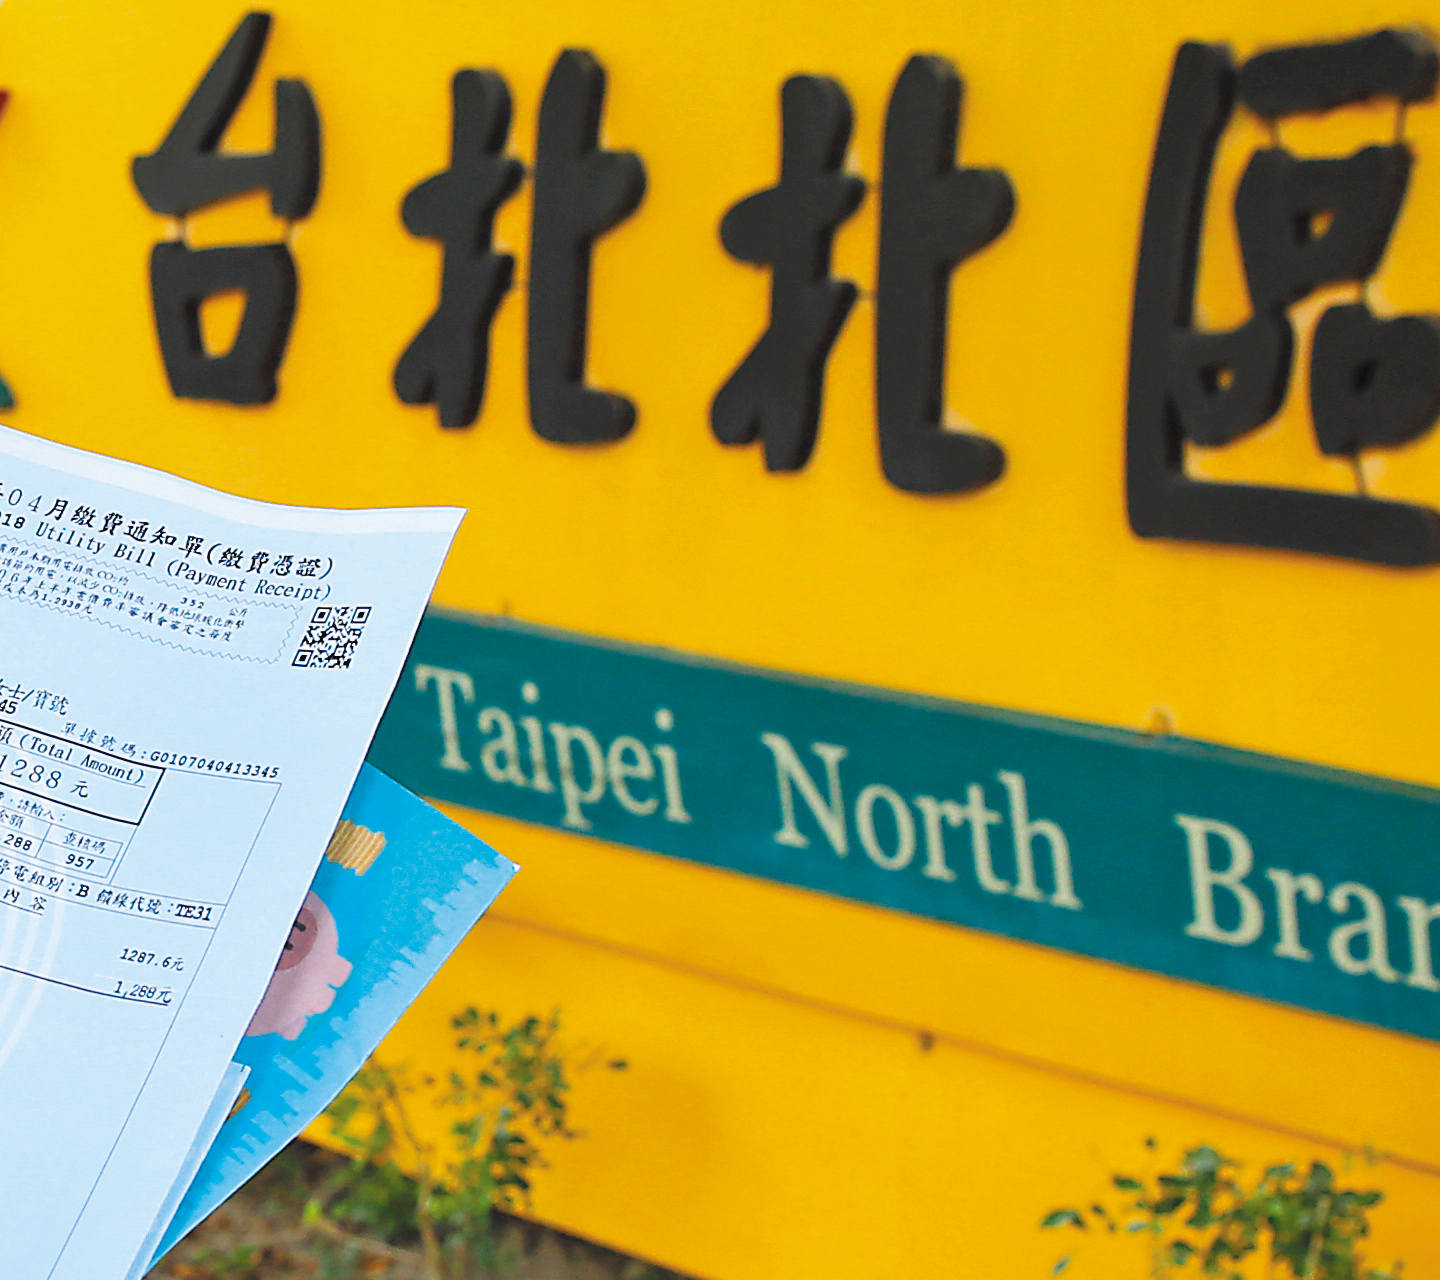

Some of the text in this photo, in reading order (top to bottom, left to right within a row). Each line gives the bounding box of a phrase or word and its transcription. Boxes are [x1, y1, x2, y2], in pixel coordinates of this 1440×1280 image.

[32, 522, 108, 555] Utility
[111, 544, 157, 567] Bill
[163, 558, 250, 593] (Payment
[253, 574, 334, 603] Receipt)
[179, 596, 205, 610] 352
[16, 732, 75, 762] (Total
[78, 752, 146, 785] Amount)
[415, 663, 691, 831] Taipei
[761, 732, 1083, 911] North
[64, 852, 94, 870] 957
